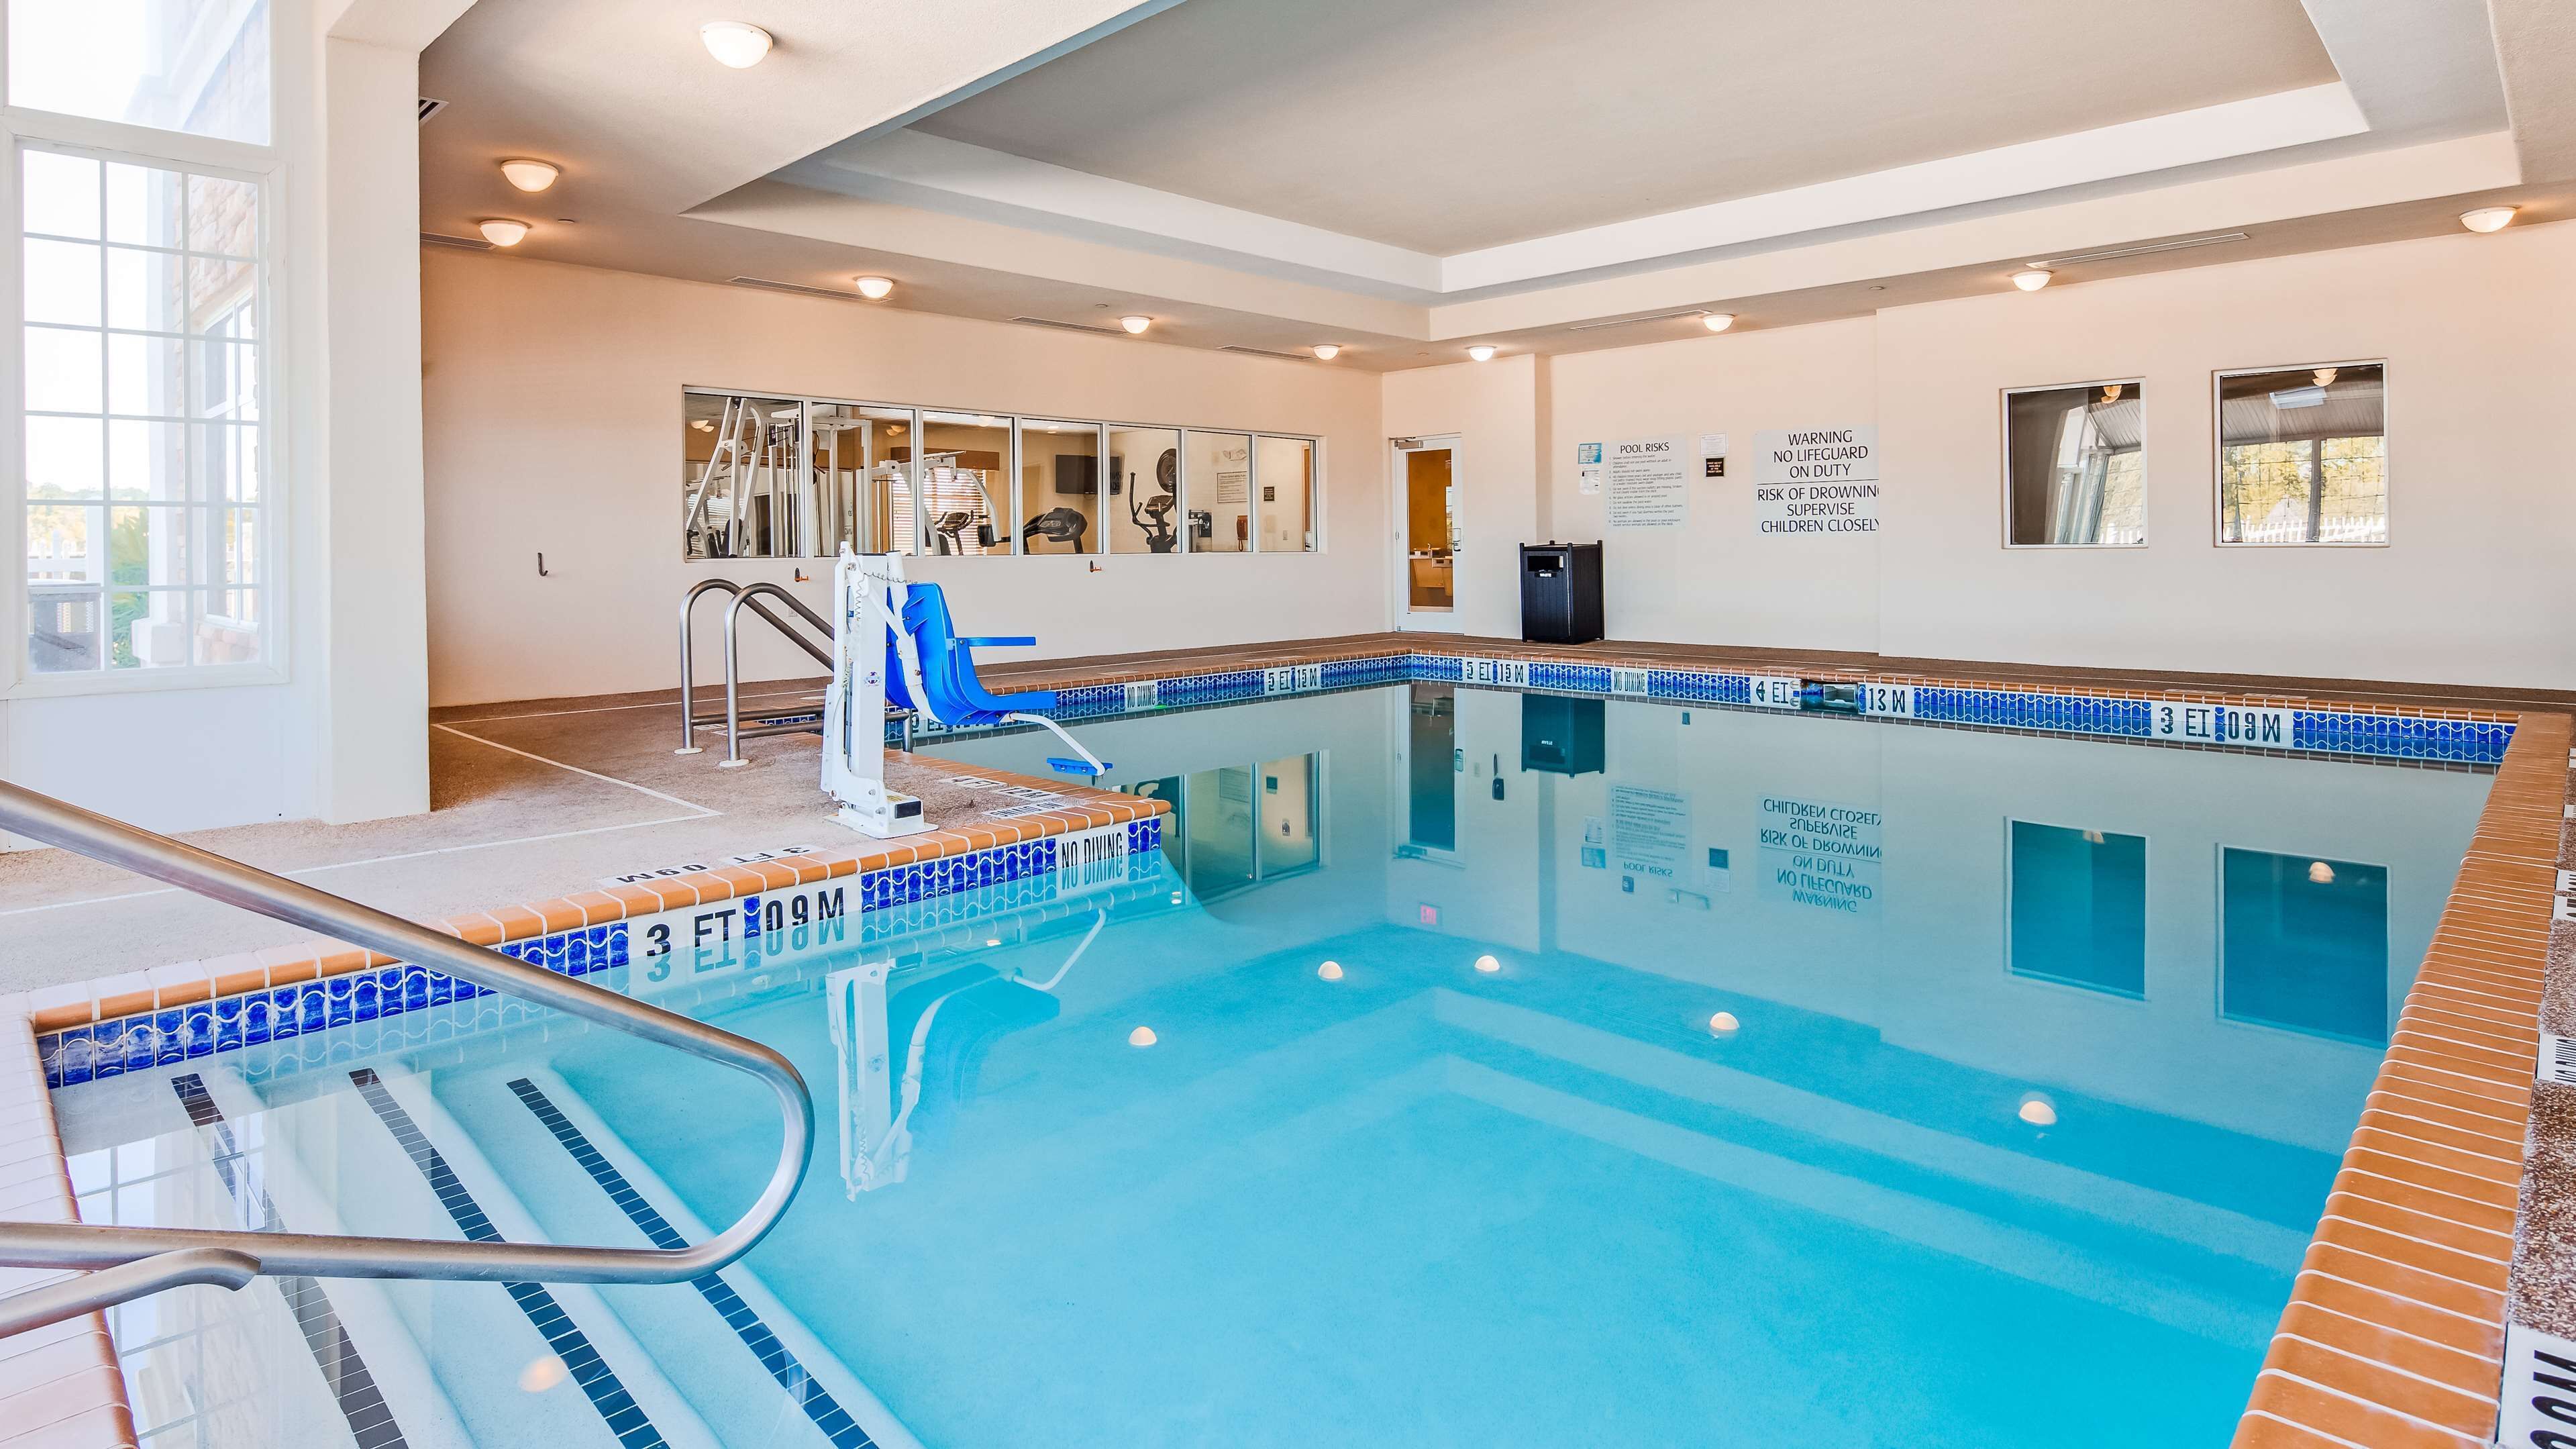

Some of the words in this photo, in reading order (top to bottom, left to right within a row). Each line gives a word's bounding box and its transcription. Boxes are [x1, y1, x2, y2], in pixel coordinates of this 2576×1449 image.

[1788, 430, 1853, 446] WARNING
[1620, 444, 1643, 454] POOL
[1645, 442, 1669, 452] RISKS
[1773, 450, 1792, 463] NO
[1798, 446, 1868, 462] LIFEGUARD
[1790, 466, 1809, 478] ON
[1814, 463, 1851, 477] DUTY
[1757, 488, 1784, 501] RISK
[1789, 487, 1805, 500] OF
[1810, 485, 1879, 499] DROWNIN
[1787, 503, 1855, 516] SUPERVISE
[1761, 519, 1823, 532] CHILDREN
[1062, 840, 1078, 868] NO
[1084, 832, 1123, 864] DIVING
[646, 923, 671, 956] 3
[694, 909, 736, 948] FT
